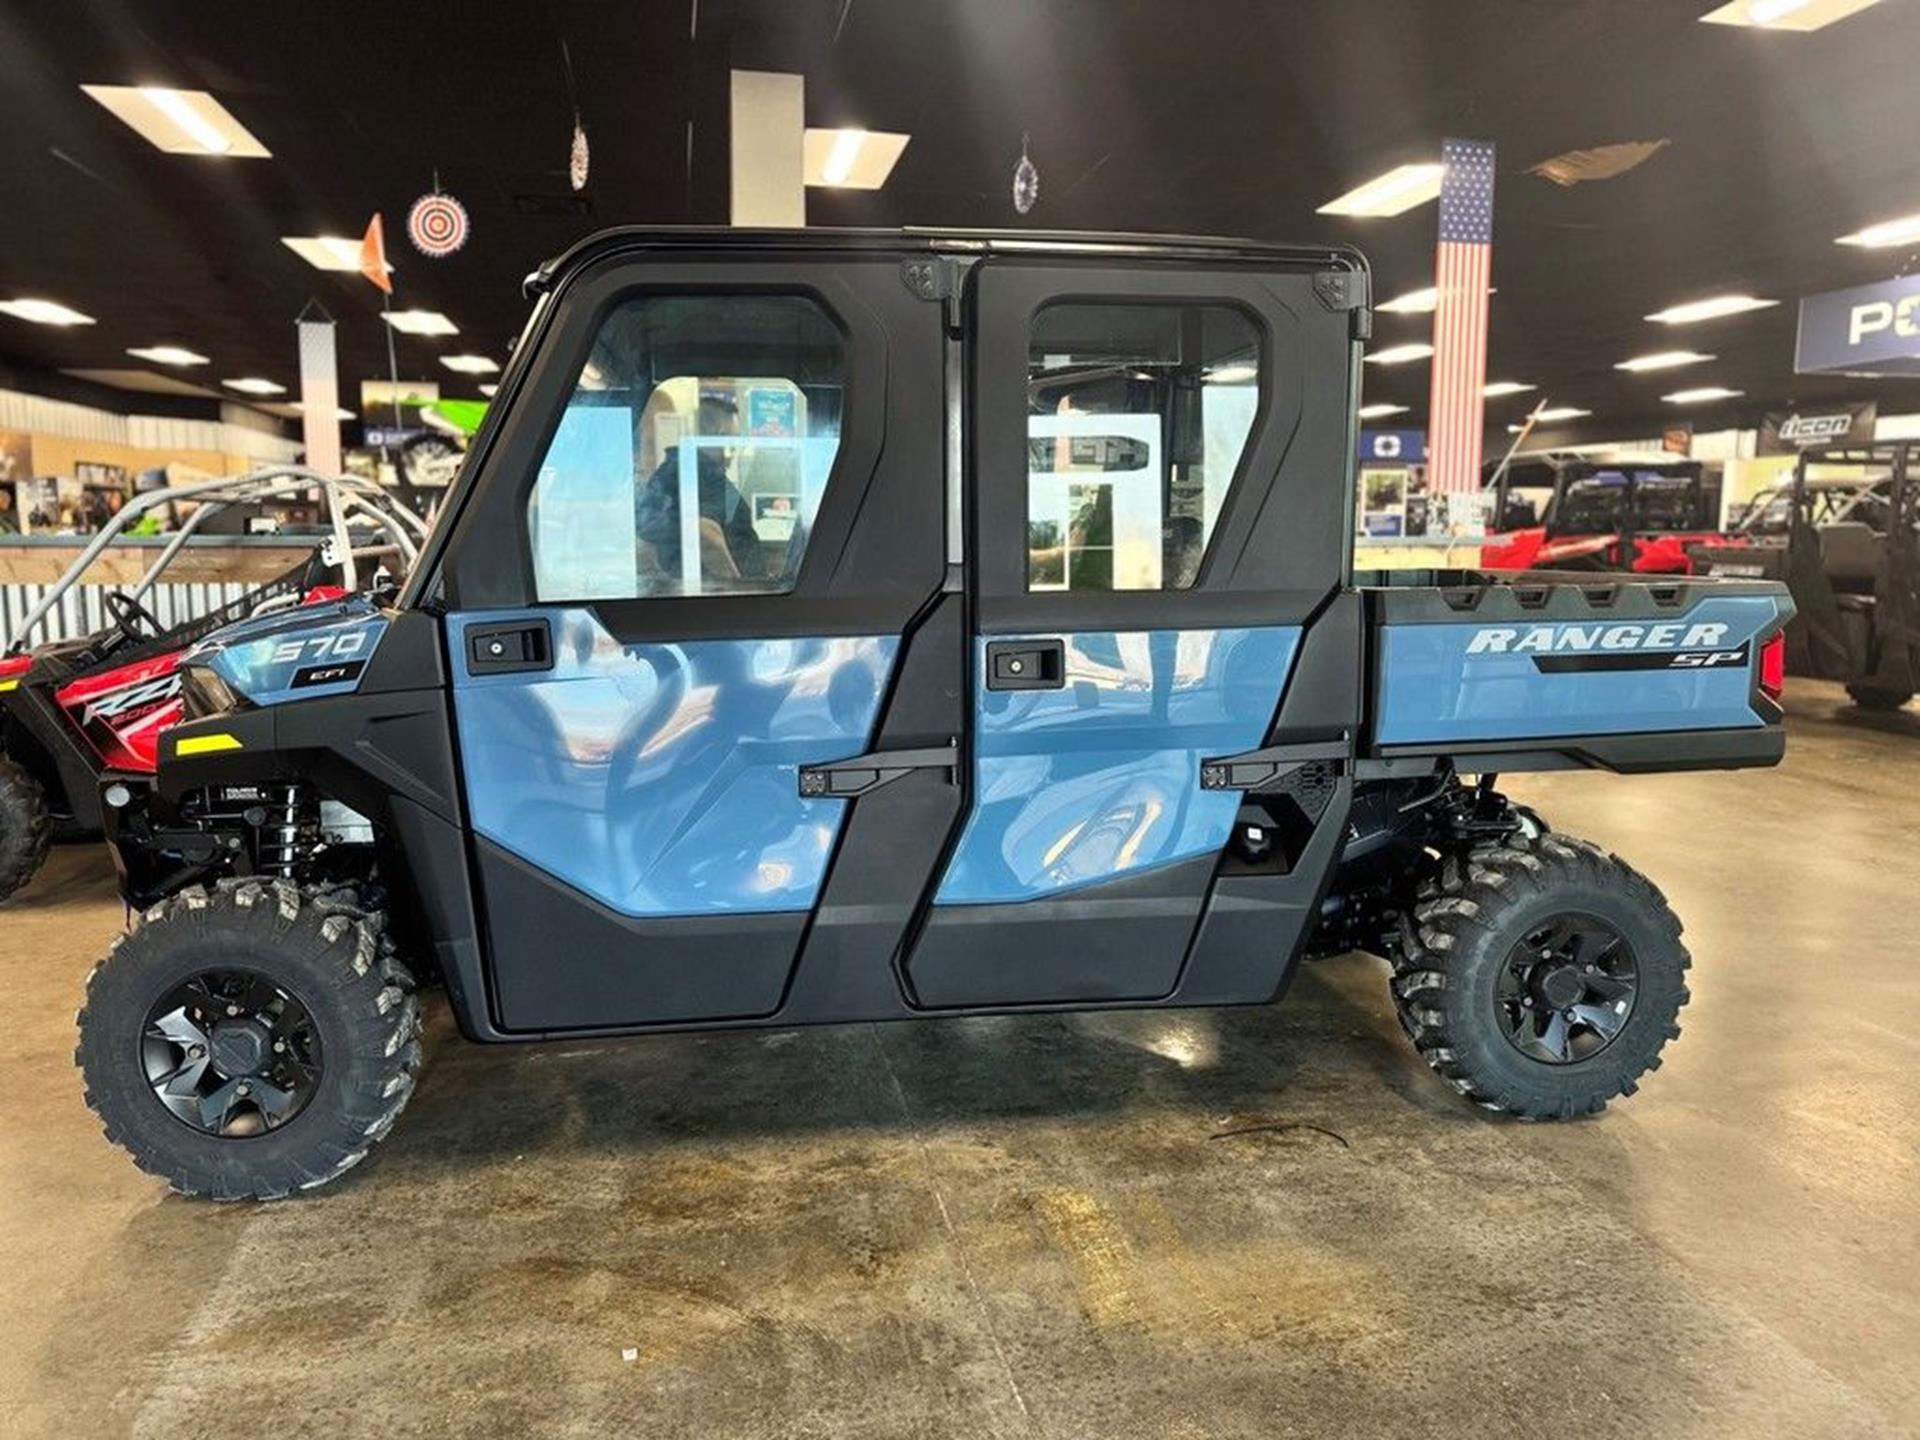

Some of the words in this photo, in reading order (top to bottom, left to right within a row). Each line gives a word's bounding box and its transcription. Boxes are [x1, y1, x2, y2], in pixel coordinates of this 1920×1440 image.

[272, 631, 366, 664] 570
[1465, 622, 1729, 655] RANGER
[1668, 651, 1744, 668] SP
[309, 667, 346, 681] EFI
